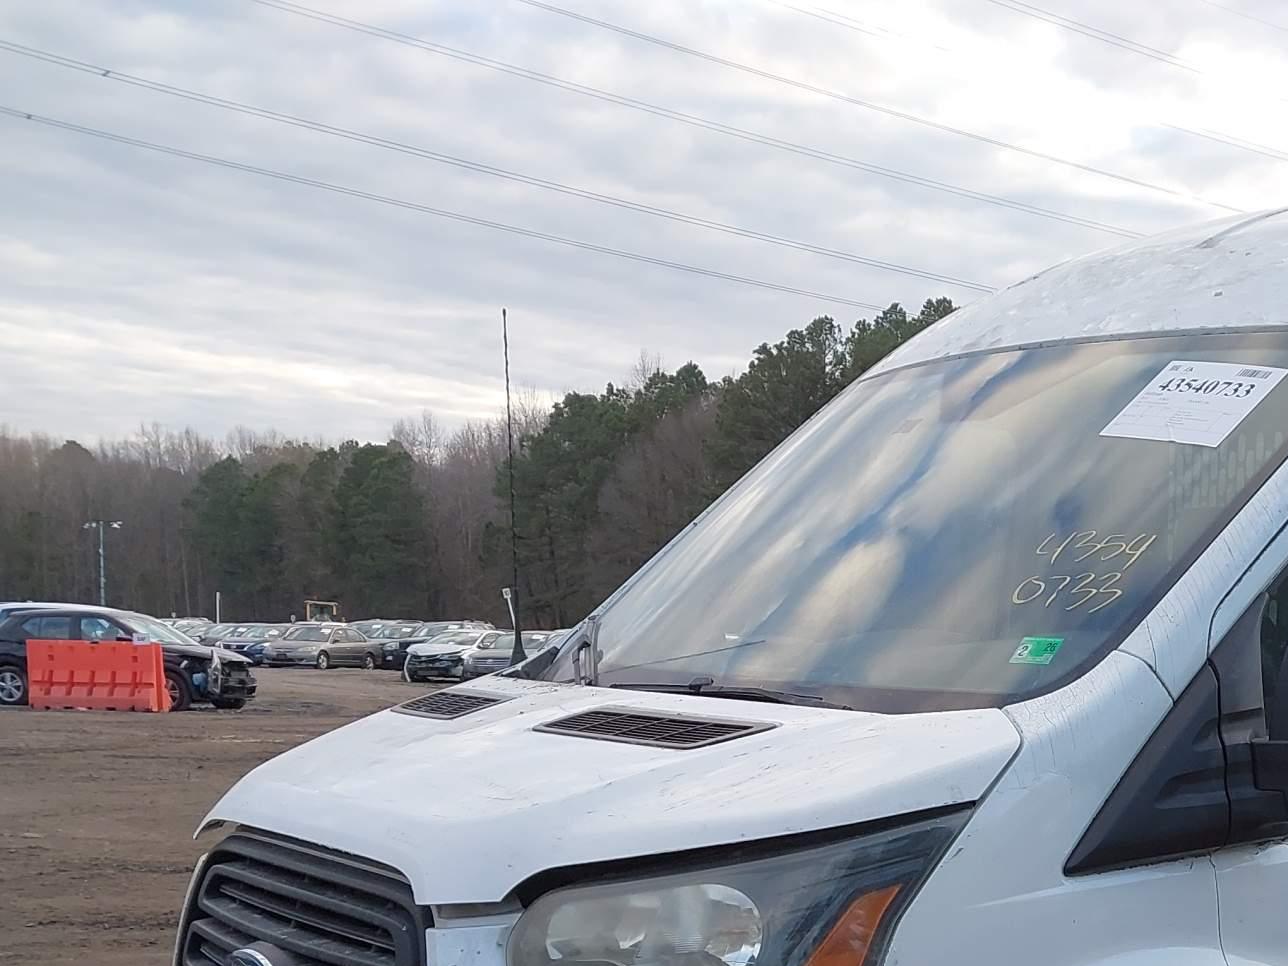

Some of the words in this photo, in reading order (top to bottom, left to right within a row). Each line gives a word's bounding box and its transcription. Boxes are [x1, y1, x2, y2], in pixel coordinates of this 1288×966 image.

[1158, 377, 1256, 398] 43540733
[1036, 530, 1157, 570] 4354
[1012, 572, 1123, 613] 0733
[1017, 645, 1029, 657] 2
